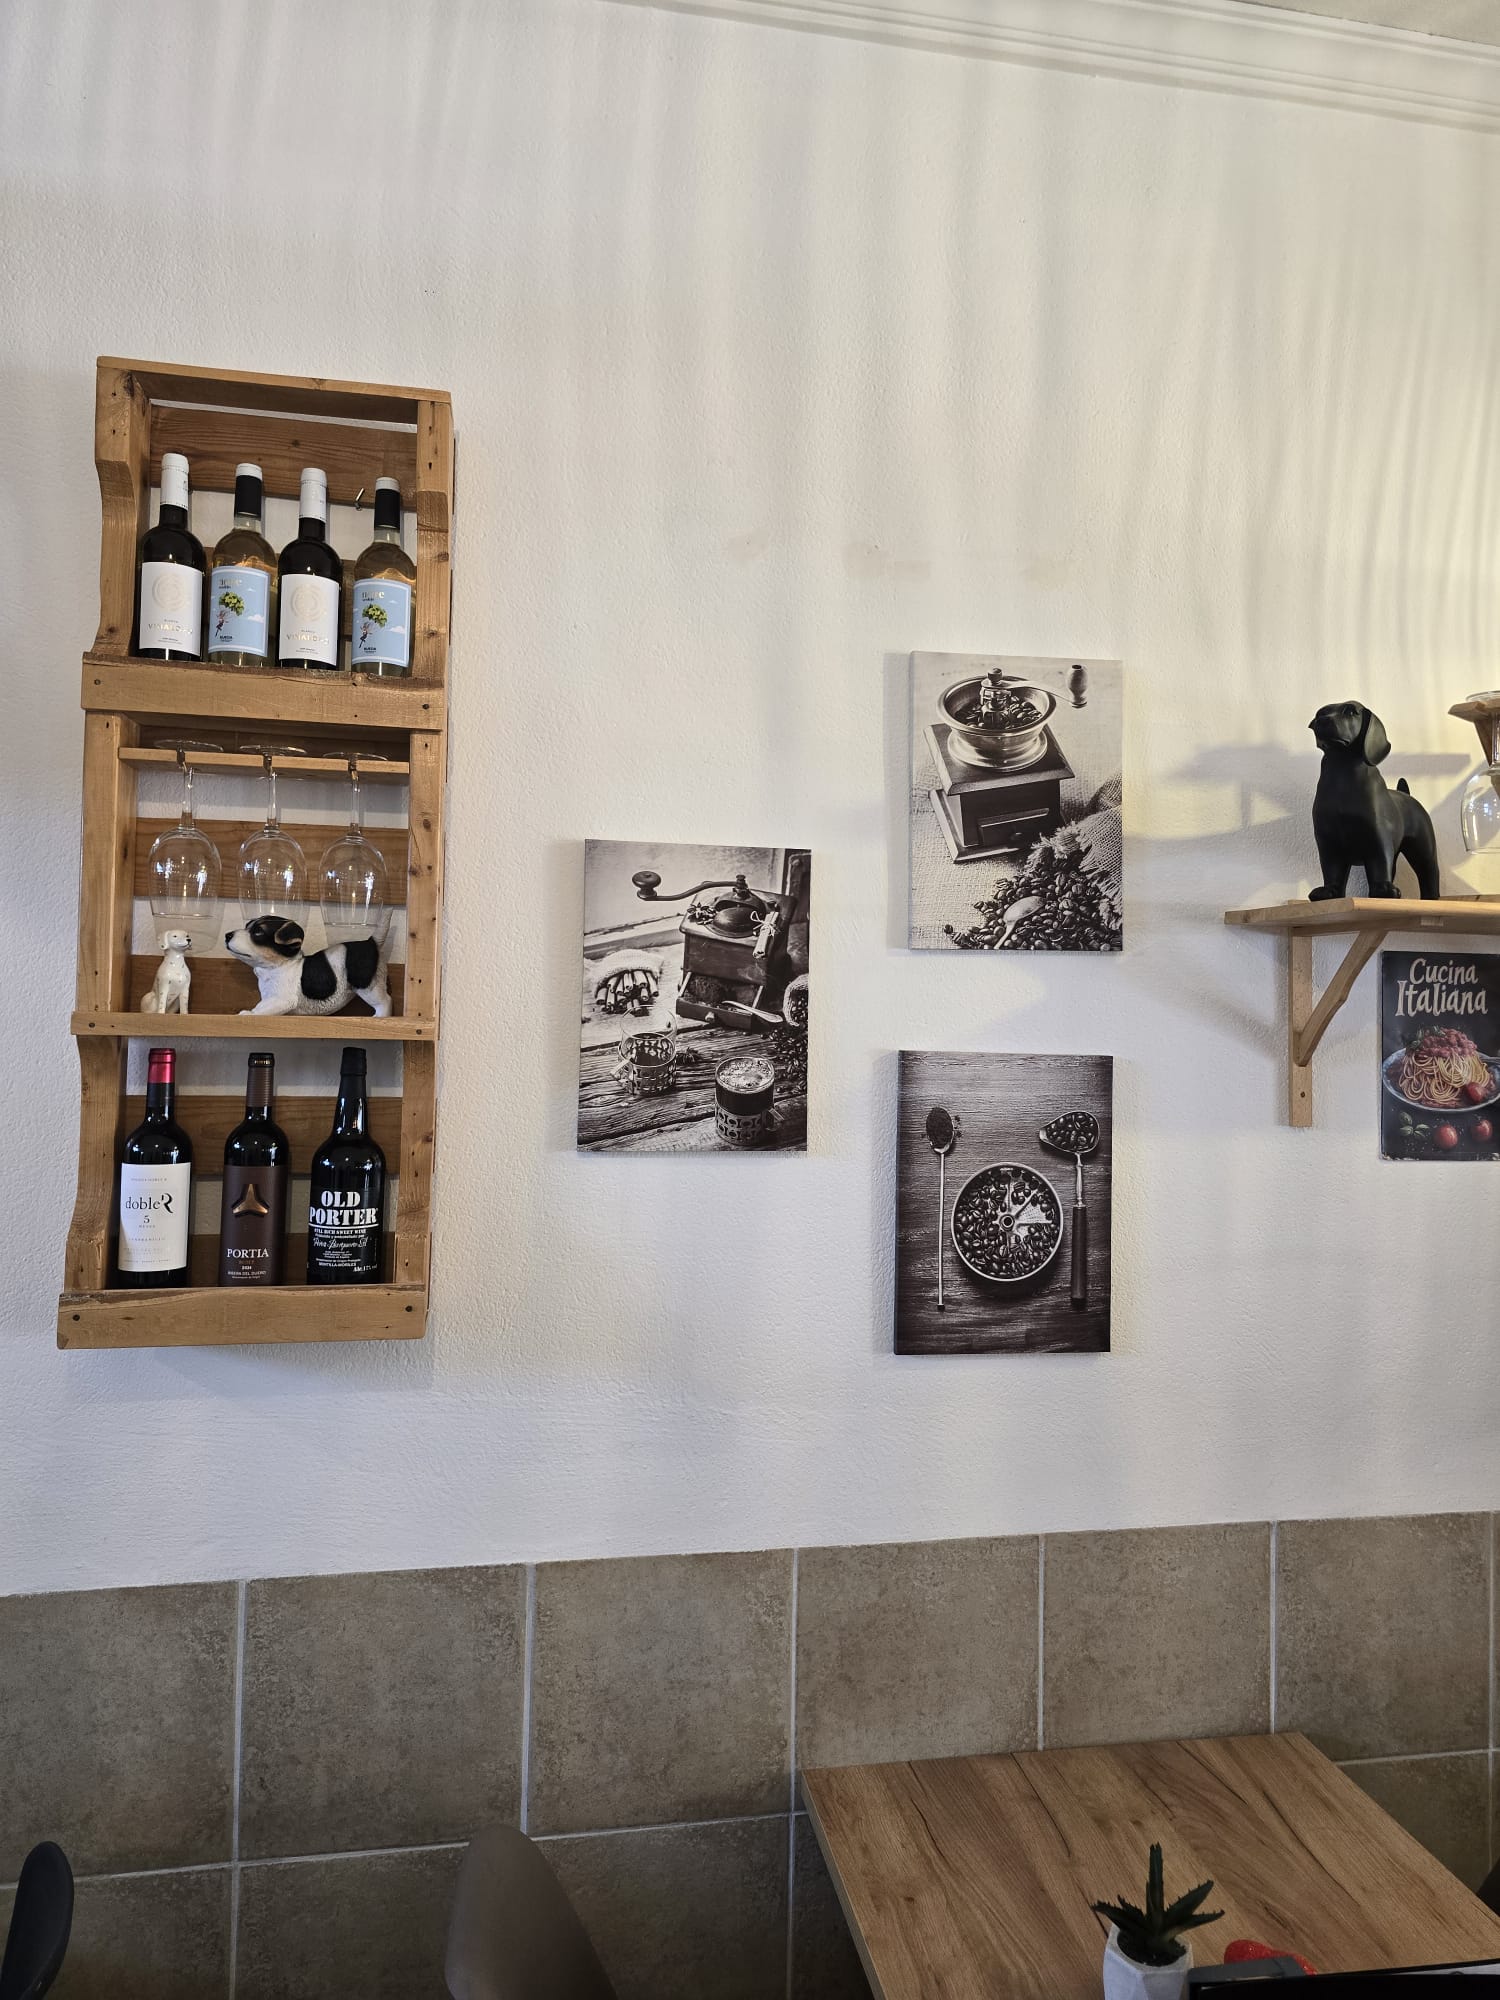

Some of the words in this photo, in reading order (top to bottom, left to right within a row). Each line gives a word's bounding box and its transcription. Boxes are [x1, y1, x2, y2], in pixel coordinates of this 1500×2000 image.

[1409, 958, 1479, 985] Cucina
[1395, 980, 1489, 1017] Italiana
[321, 1190, 361, 1208] OLD
[143, 1214, 151, 1224] 5
[309, 1206, 377, 1226] PORTER
[226, 1247, 270, 1258] PORTIA
